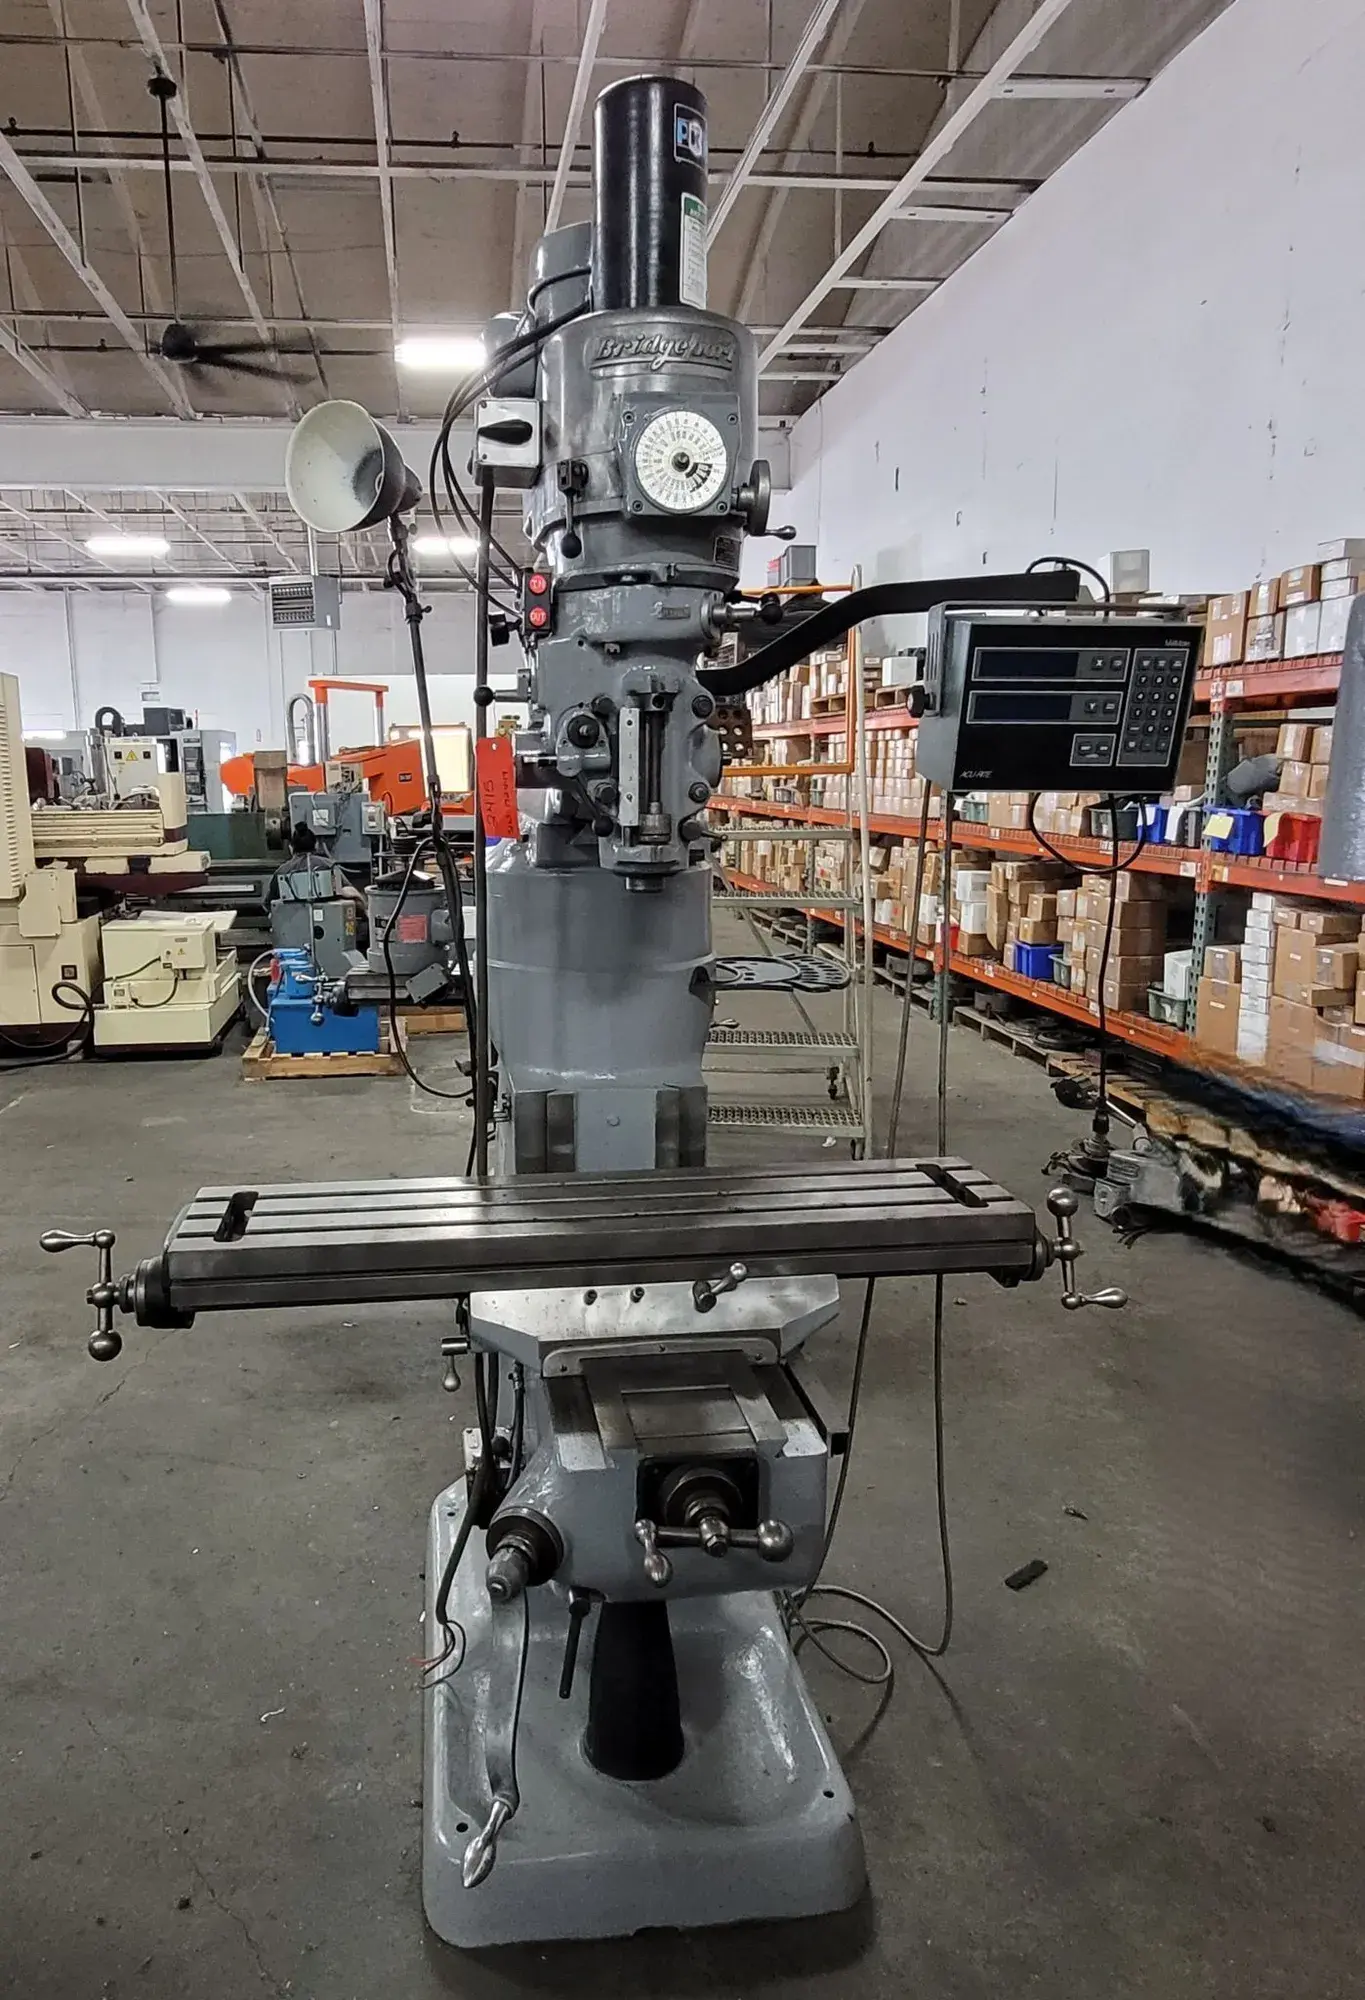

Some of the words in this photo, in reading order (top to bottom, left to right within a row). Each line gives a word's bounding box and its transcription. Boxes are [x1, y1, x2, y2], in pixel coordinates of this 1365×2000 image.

[595, 334, 734, 371] Bridgeport
[1095, 659, 1103, 667] X
[1089, 702, 1096, 710] Y
